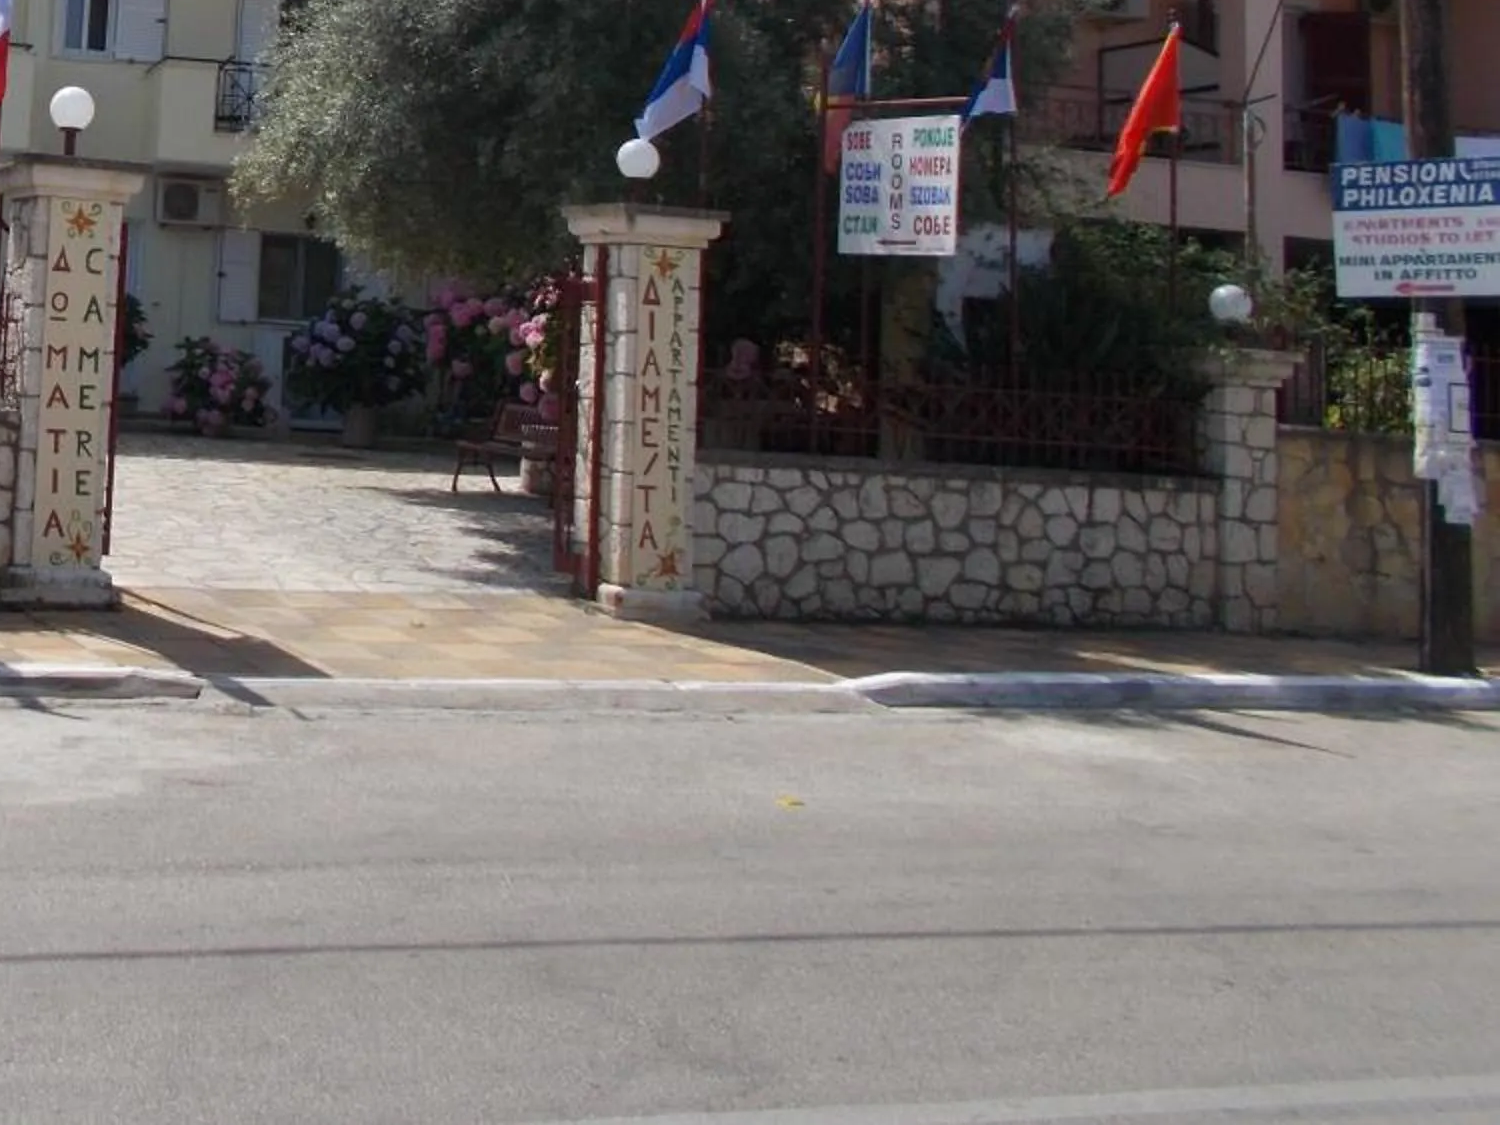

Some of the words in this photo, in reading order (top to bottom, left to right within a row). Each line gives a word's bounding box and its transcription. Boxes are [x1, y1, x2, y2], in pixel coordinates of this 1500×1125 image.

[847, 131, 872, 151] SOBE
[890, 133, 903, 230] ROOMS
[1341, 162, 1456, 186] PENSION
[1342, 183, 1494, 207] PHILOXENIA
[1344, 217, 1463, 230] APARTMENTS
[1352, 232, 1432, 245] STUDIOS
[1439, 232, 1460, 244] TO
[1339, 256, 1375, 267] MINI
[1374, 270, 1393, 281] IN
[1400, 267, 1477, 281] AFFITTO
[74, 247, 104, 497] CAMERE
[666, 276, 685, 504] APPARTAMENTI
